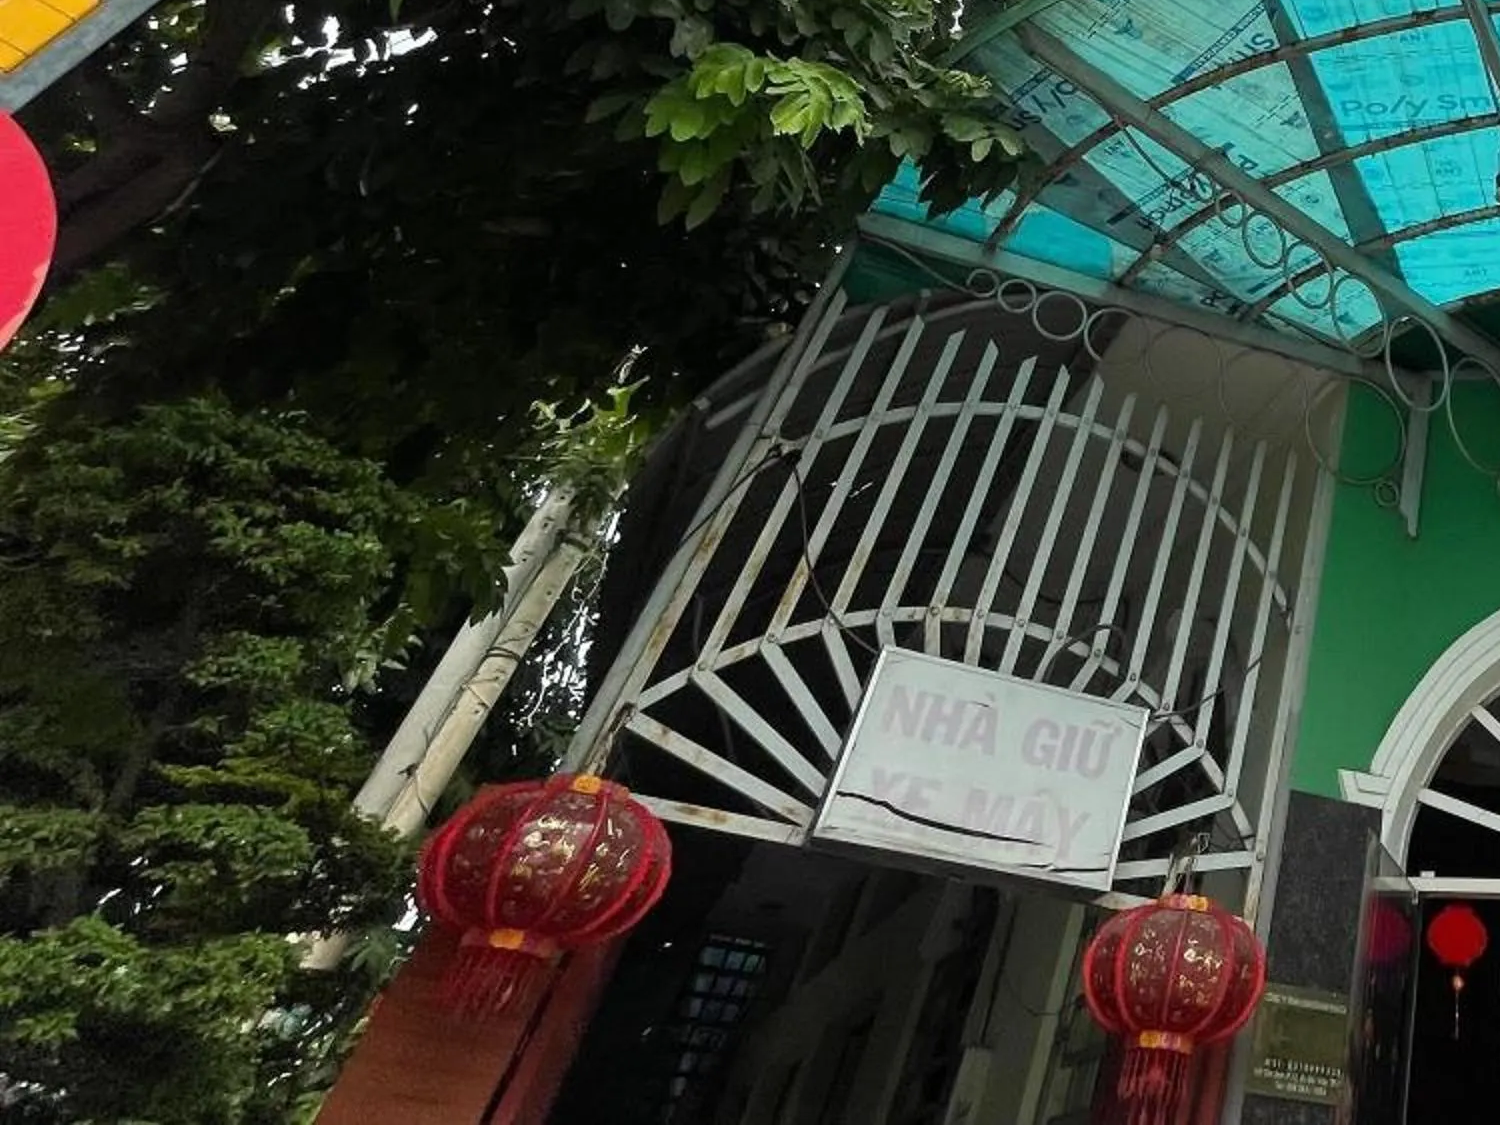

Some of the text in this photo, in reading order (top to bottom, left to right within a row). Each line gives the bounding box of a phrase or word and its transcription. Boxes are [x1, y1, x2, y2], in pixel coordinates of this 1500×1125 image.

[1340, 94, 1428, 118] Poly
[882, 684, 1125, 782] NHÀ GIỮ
[866, 764, 942, 832] XE
